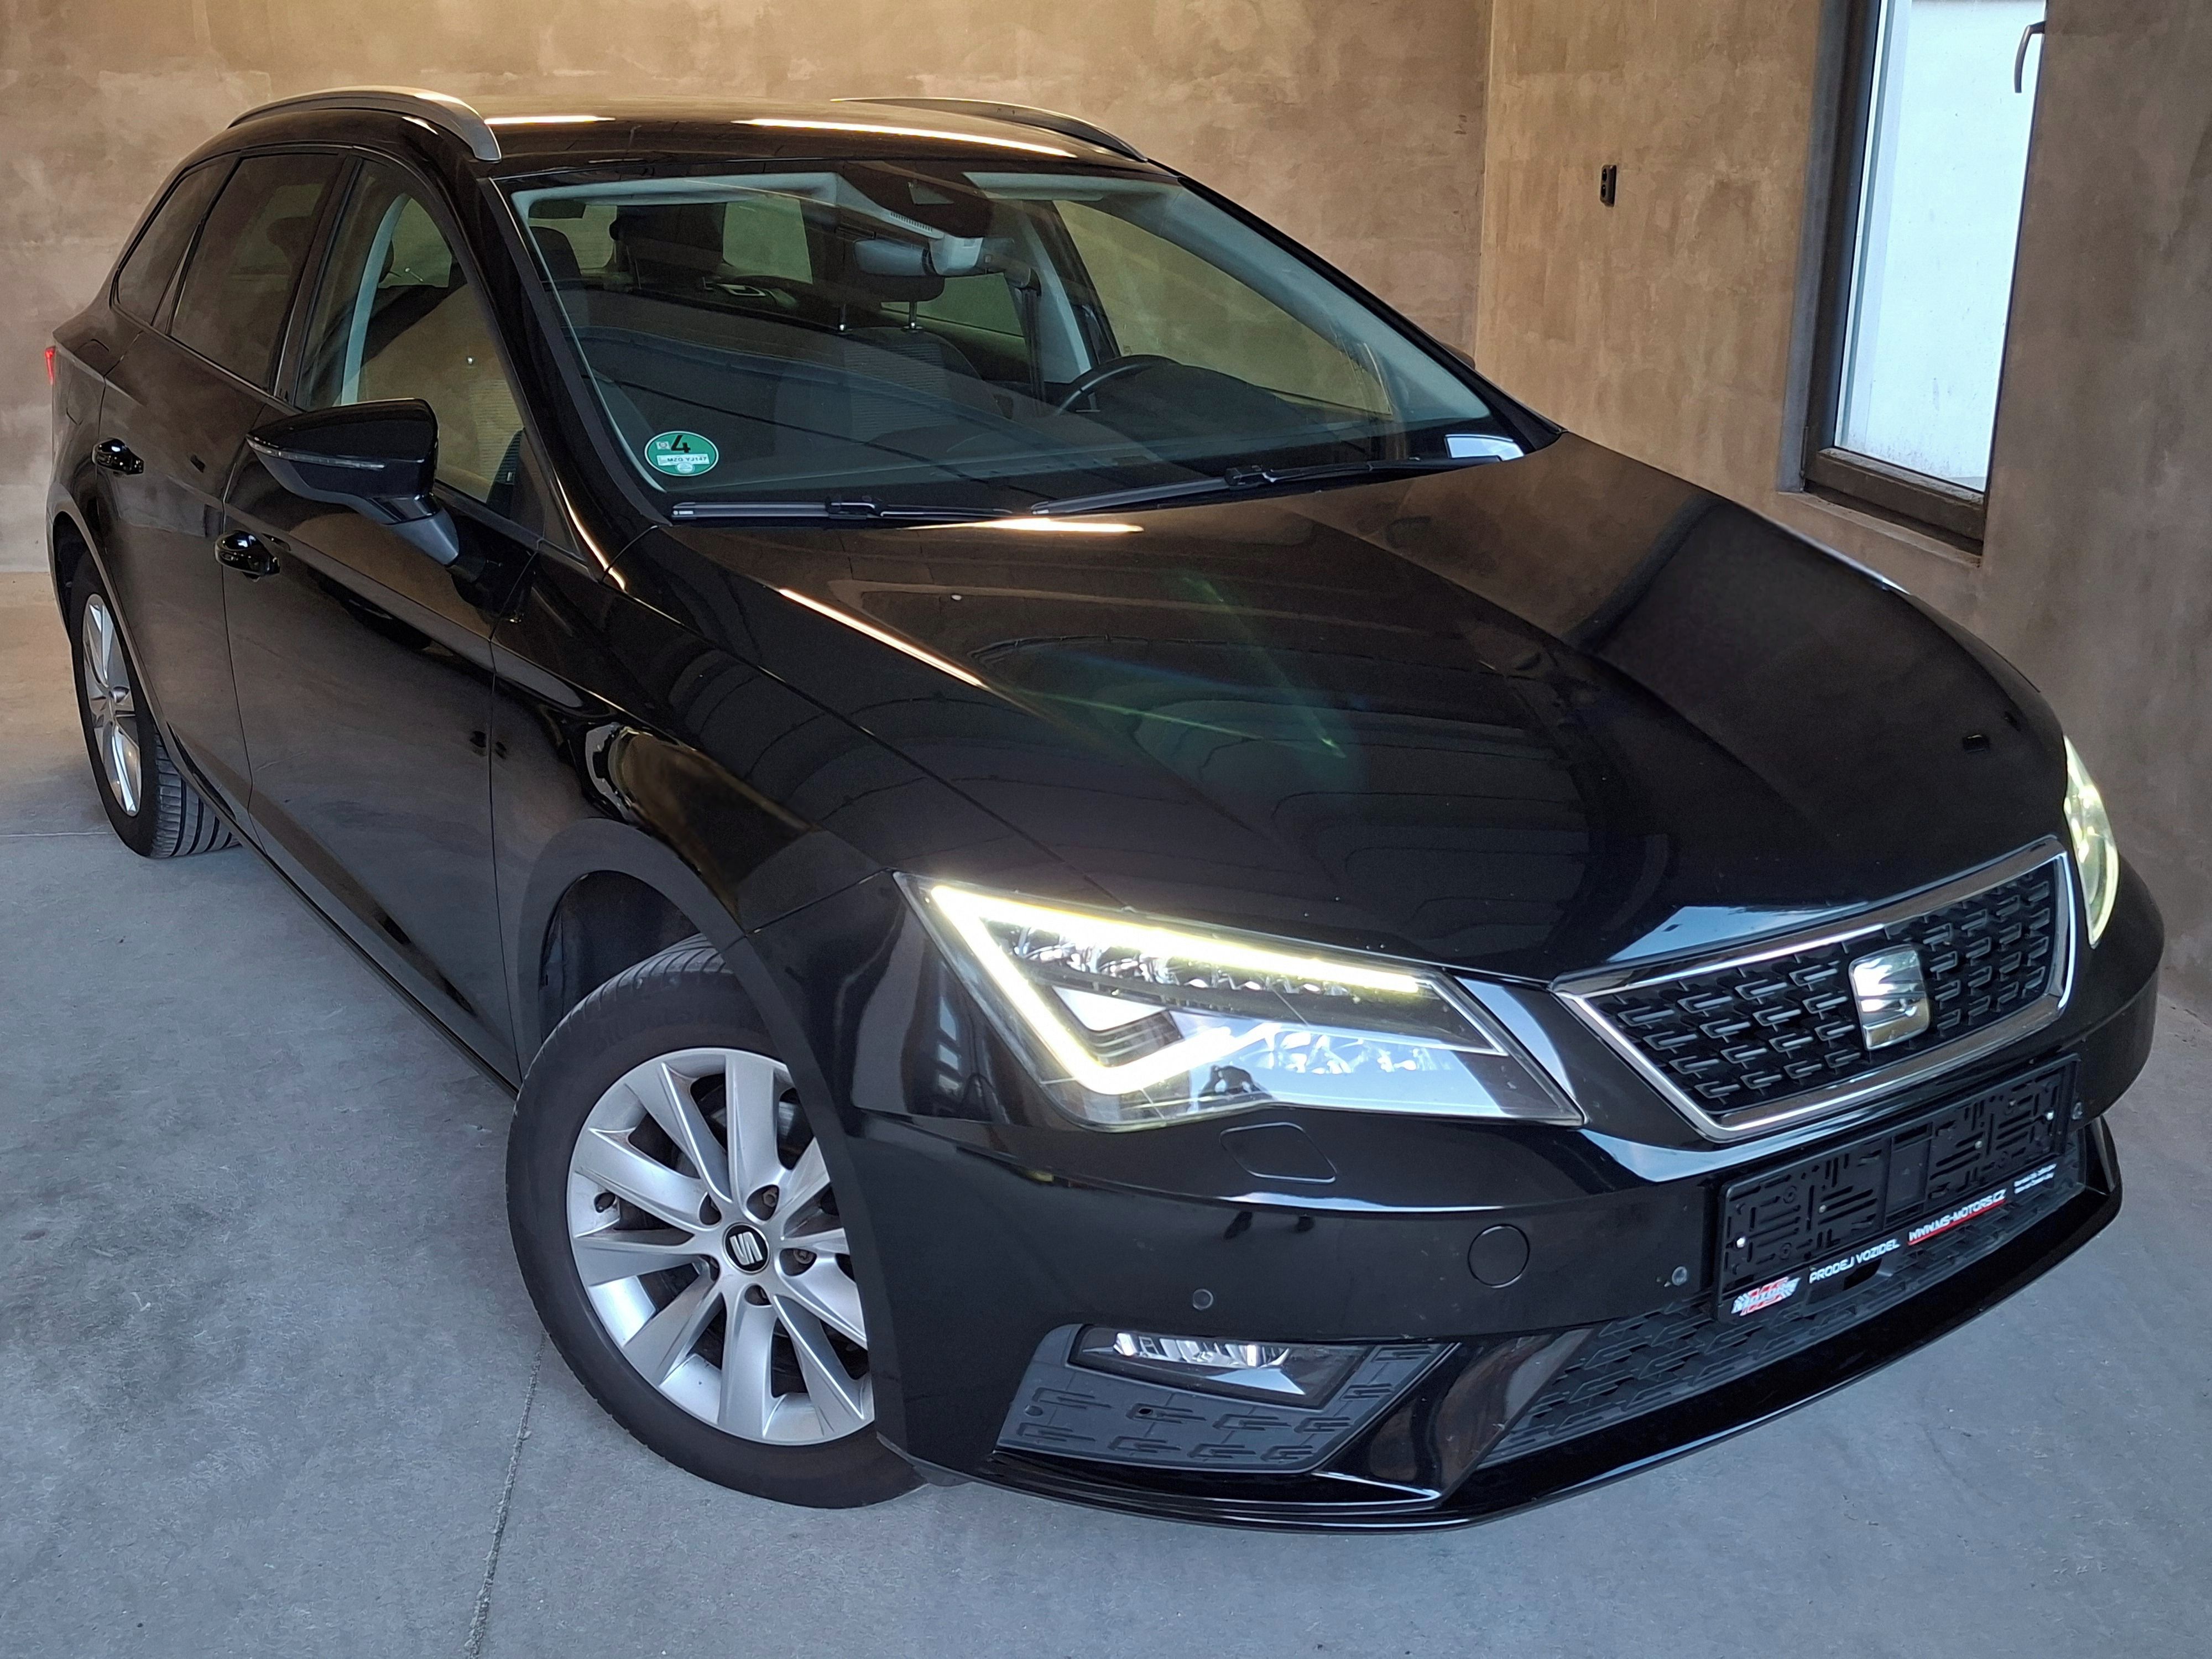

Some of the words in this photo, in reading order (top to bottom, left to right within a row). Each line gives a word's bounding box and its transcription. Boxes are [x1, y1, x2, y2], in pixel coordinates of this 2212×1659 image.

[671, 435, 691, 453] 4
[1809, 1256, 1855, 1284] PRODEJ
[1856, 1239, 1901, 1264] VOZIDEL
